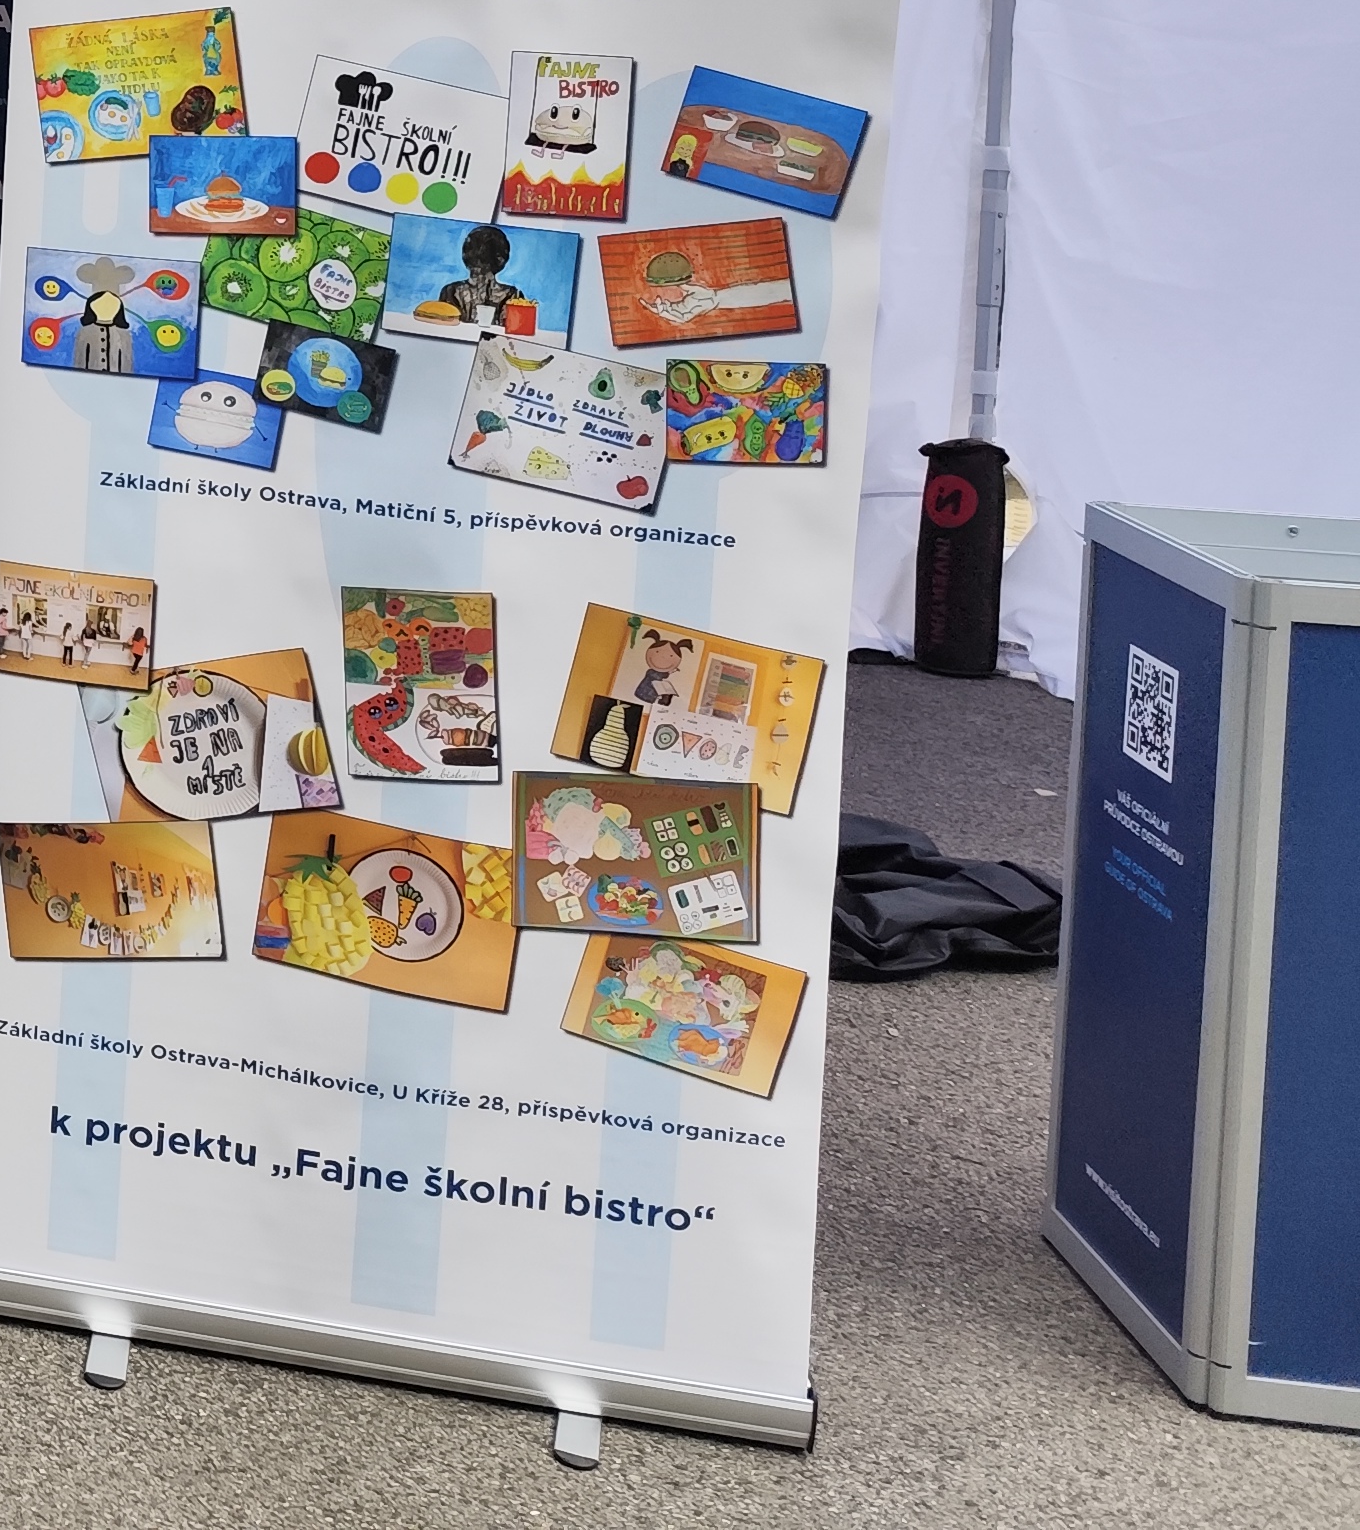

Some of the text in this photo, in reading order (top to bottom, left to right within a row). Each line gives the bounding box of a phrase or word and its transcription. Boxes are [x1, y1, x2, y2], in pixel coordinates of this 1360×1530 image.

[331, 122, 473, 185] BISTRO!!!
[337, 107, 458, 146] FAJNE ŠKOLNÍ
[99, 471, 737, 549] Základní školy Ostrava, Matiční 5, příspěvková organizace
[169, 727, 243, 764] JE NA
[89, 1032, 144, 1059] školy
[150, 1043, 386, 1101] Ostrava-Michálkovice,
[392, 1083, 408, 1101] U
[415, 1086, 471, 1109] Kříže
[477, 1095, 510, 1116] 28,
[517, 1098, 654, 1133] příspěvková
[661, 1118, 787, 1149] organizace
[49, 1105, 716, 1233] k projektu „Fajne školní bistro“
